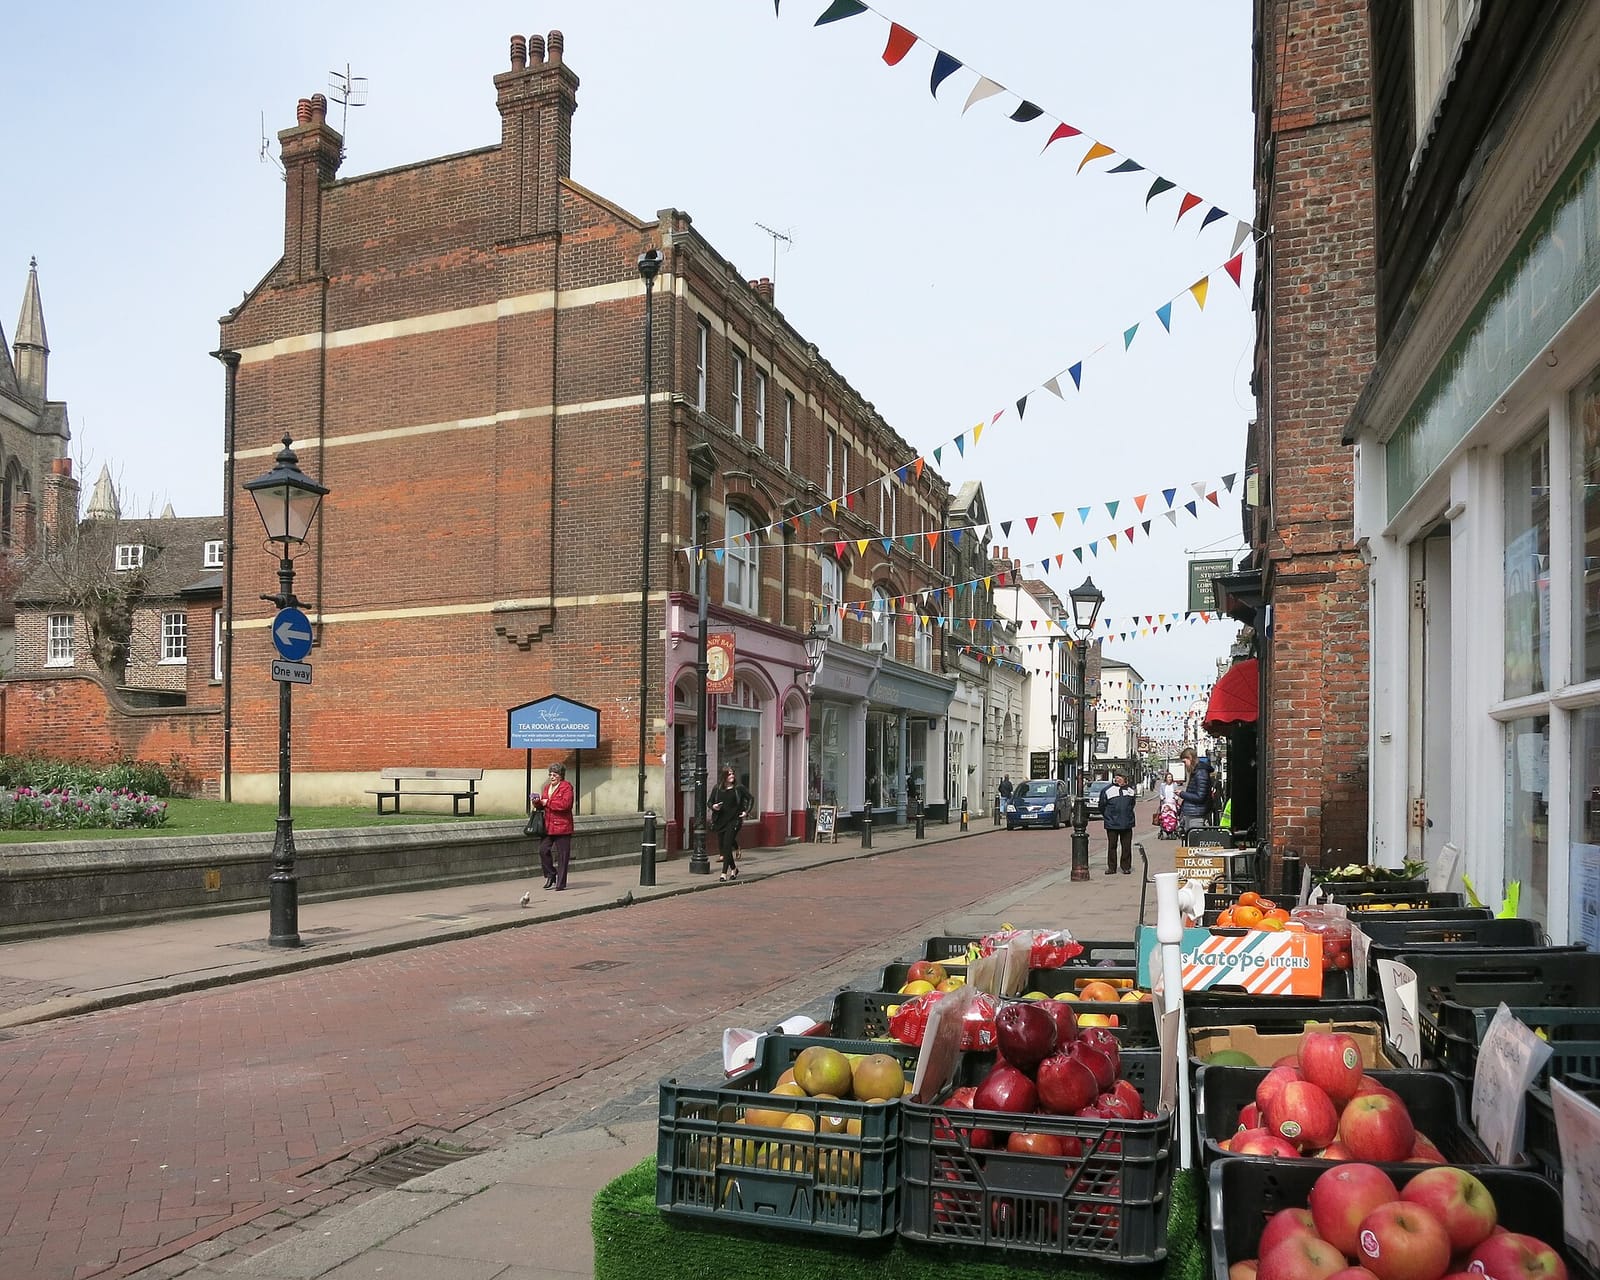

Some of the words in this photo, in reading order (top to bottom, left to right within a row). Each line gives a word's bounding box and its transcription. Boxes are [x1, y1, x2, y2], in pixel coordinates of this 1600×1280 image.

[1450, 143, 1600, 418] ROCHEST
[273, 665, 291, 677] One
[293, 669, 310, 680] way
[707, 676, 733, 688] CHESTER
[819, 814, 833, 825] SUN
[1183, 858, 1197, 866] TEA
[1197, 858, 1213, 867] CAKE
[1177, 868, 1189, 877] HOT
[1270, 958, 1309, 968] LITCHIS
